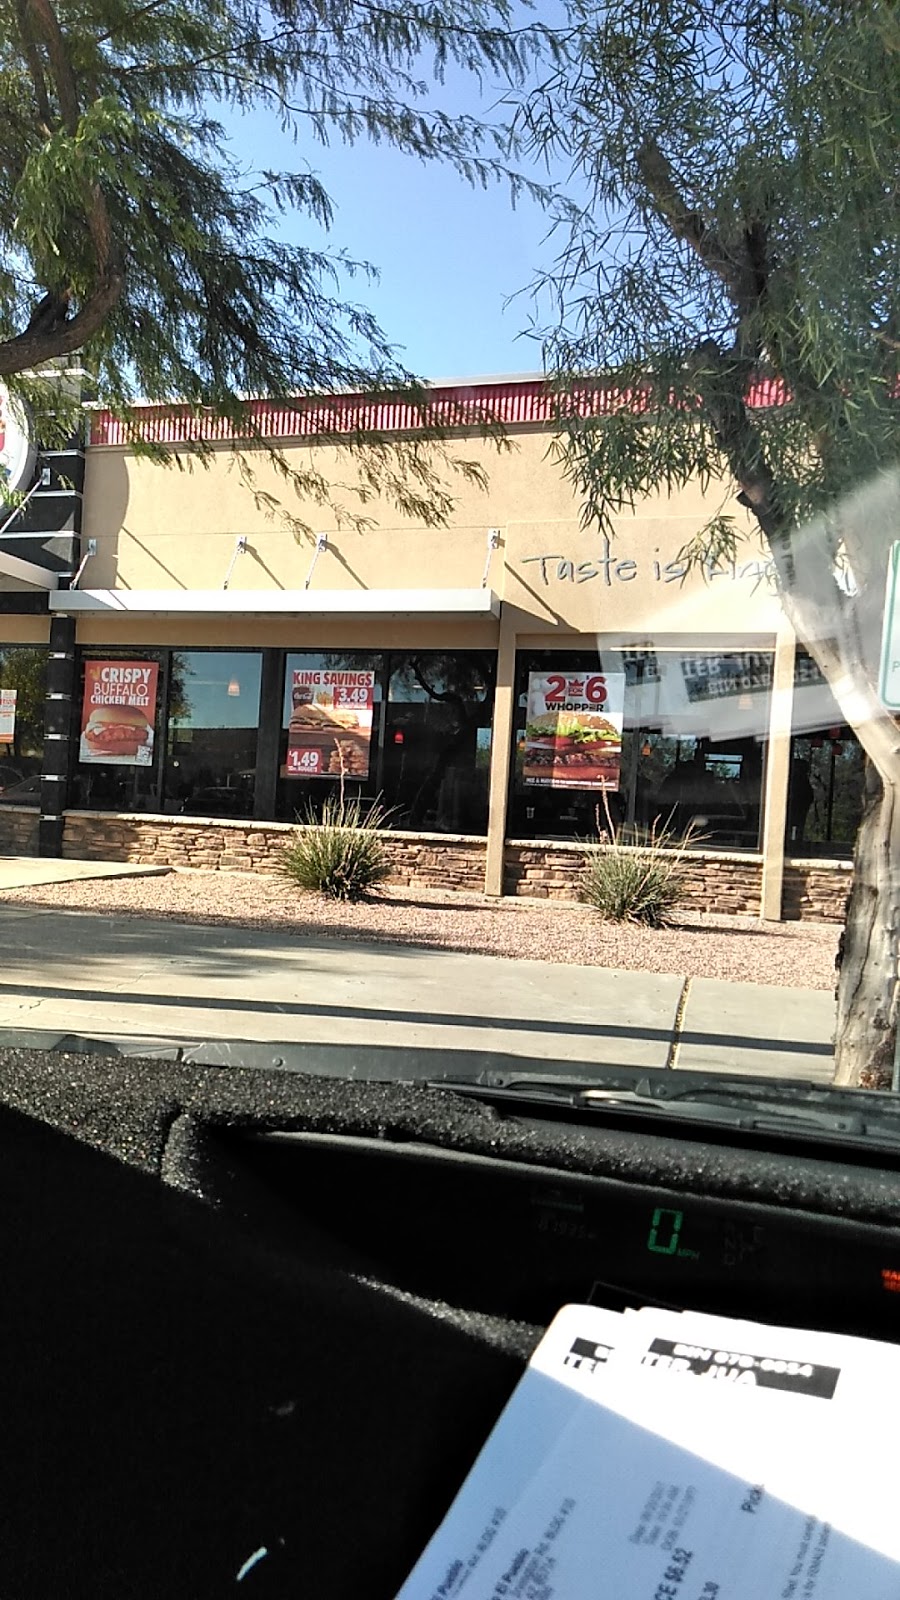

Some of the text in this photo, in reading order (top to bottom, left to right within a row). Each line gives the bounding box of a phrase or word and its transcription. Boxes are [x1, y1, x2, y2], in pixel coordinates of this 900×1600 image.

[521, 538, 637, 586] Taste
[654, 547, 684, 583] is
[101, 667, 152, 684] CRISPY
[293, 672, 321, 685] KING
[93, 682, 148, 697] BUFFALO
[544, 675, 566, 702] 2
[90, 694, 149, 706] CHICKEN MELT
[544, 703, 605, 712] WHOPPER
[648, 1208, 683, 1255] 0
